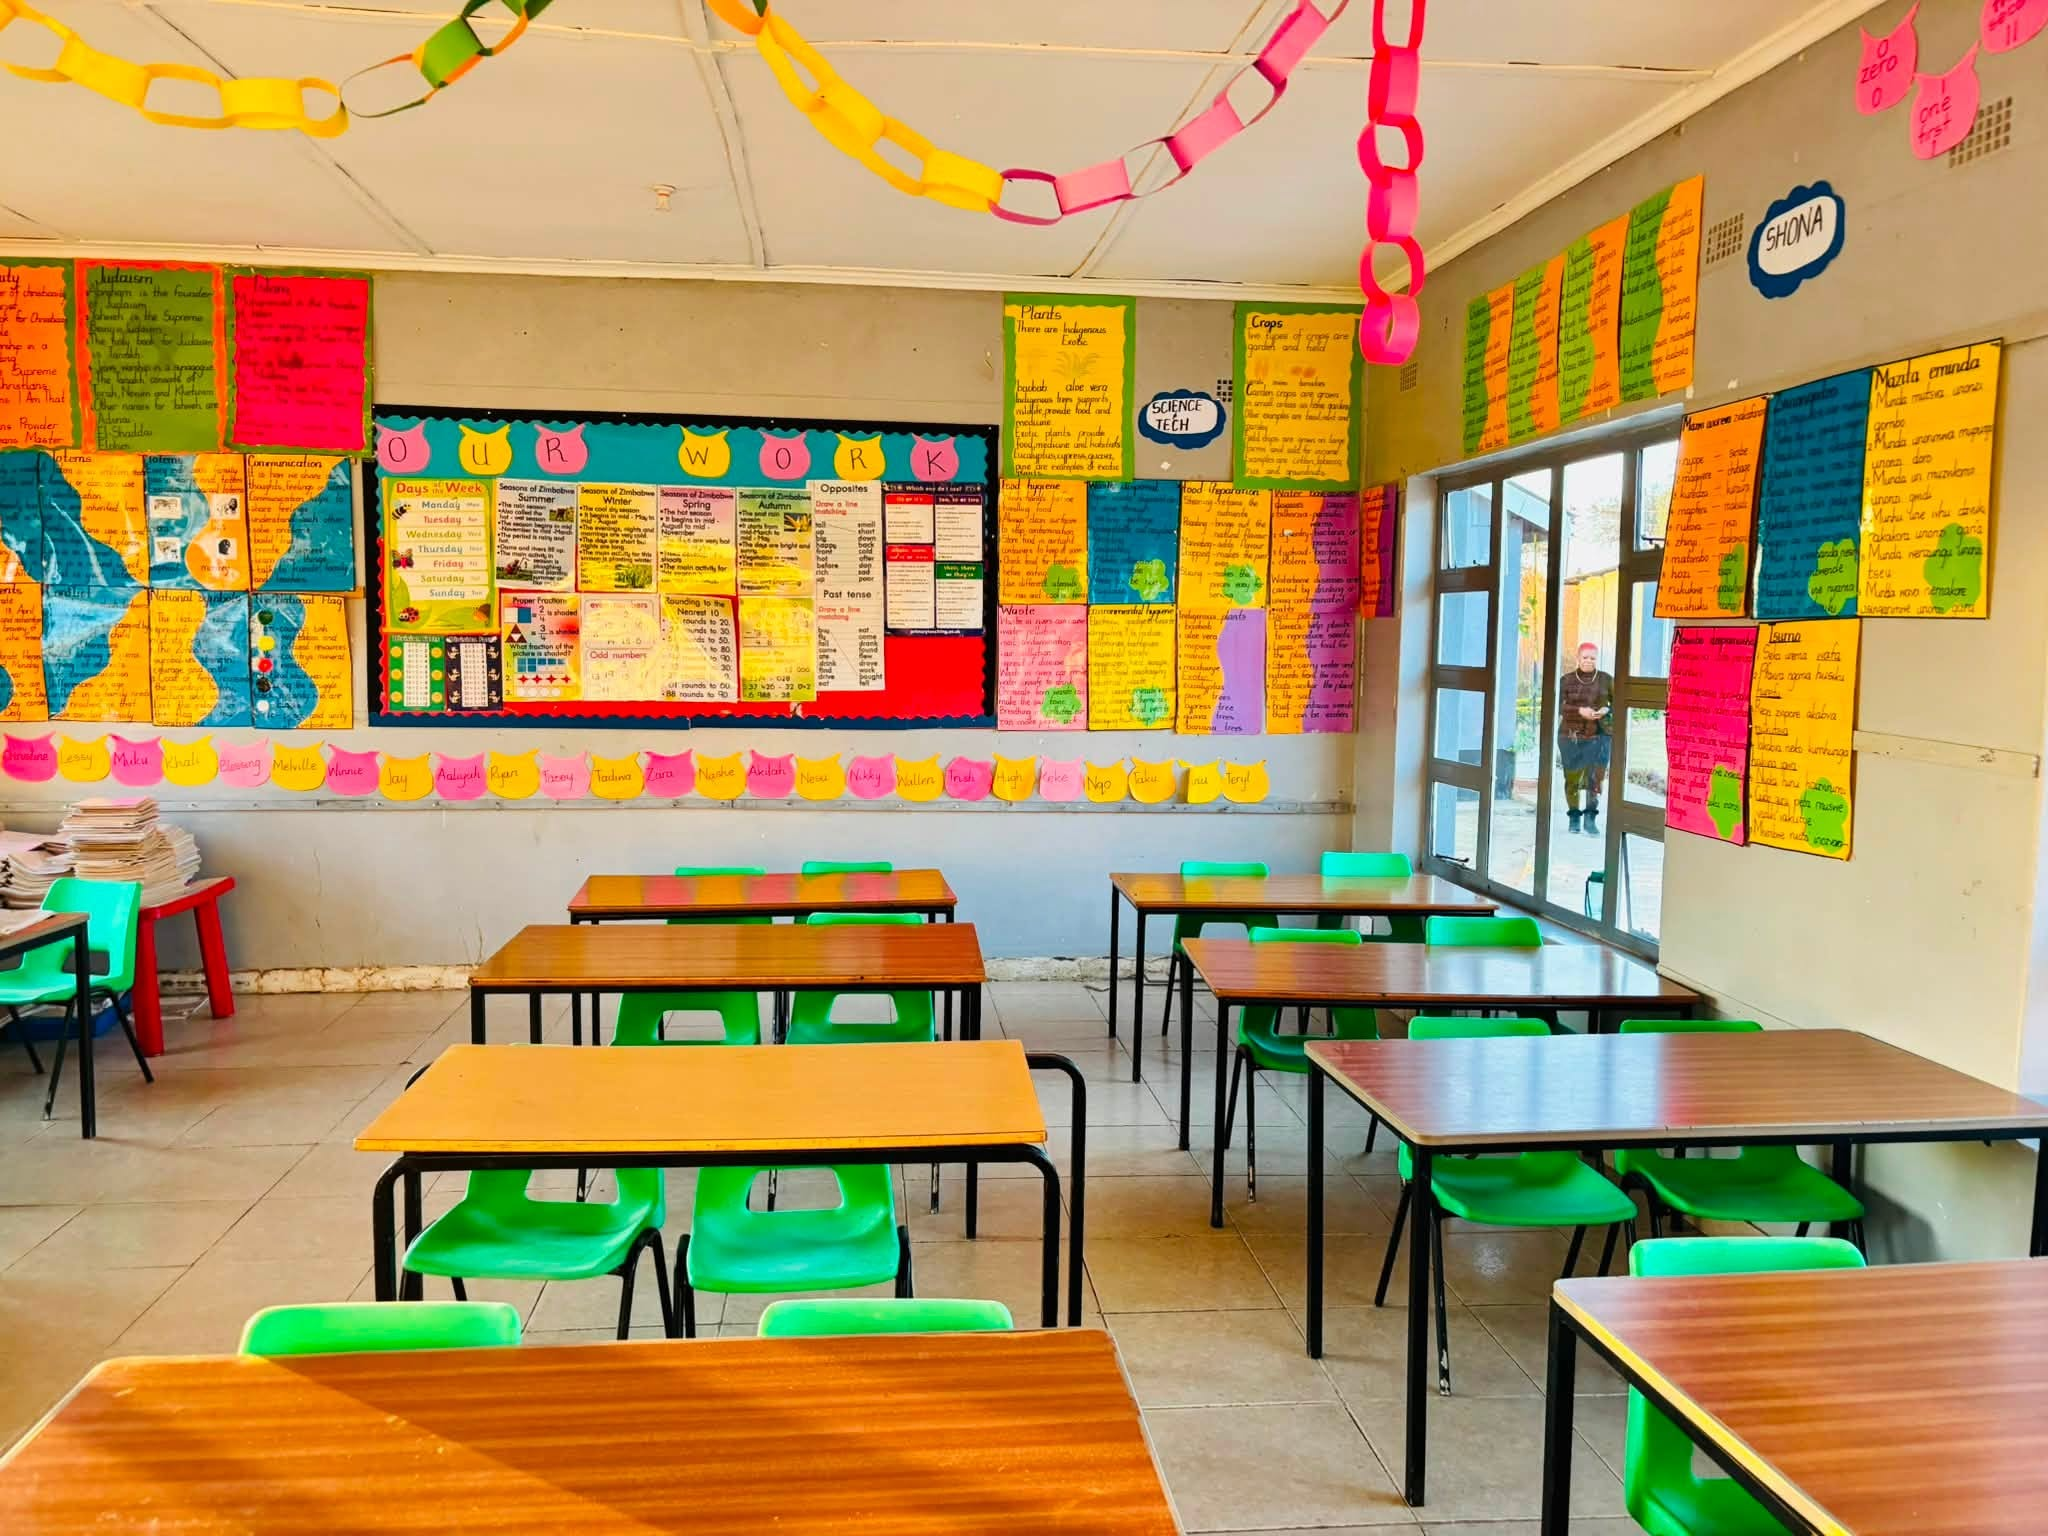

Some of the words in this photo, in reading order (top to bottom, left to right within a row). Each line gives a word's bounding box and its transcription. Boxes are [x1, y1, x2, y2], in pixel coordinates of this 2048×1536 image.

[1766, 204, 1823, 251] SHONA
[100, 266, 153, 284] Judaism
[154, 286, 168, 297] the
[164, 311, 203, 325] Supreme
[1021, 305, 1062, 321] Plants
[1017, 320, 1041, 333] There
[1063, 321, 1107, 341] Indigenous
[1252, 315, 1283, 333] Crops
[1061, 334, 1088, 346] Exotic
[12, 364, 57, 380] Supreme
[1065, 378, 1084, 392] aloe
[1090, 384, 1109, 392] vera
[1075, 402, 1091, 415] food
[1095, 402, 1112, 415] and
[1152, 400, 1203, 414] SCIENCE
[1156, 418, 1189, 432] TECH
[25, 432, 64, 445] Master
[388, 436, 568, 467] OUR
[248, 455, 322, 468] Communication
[685, 446, 947, 477] WORK
[396, 482, 429, 497] Days
[445, 482, 482, 493] Week
[500, 483, 528, 493] Seasons
[530, 485, 538, 493] of
[539, 486, 575, 495] Zimbabwe
[581, 487, 609, 496] Seasons
[610, 488, 618, 496] of
[619, 488, 656, 497] Zimbabwe
[820, 483, 869, 495] Opposites
[1027, 479, 1060, 496] hygiene
[518, 493, 556, 504] Summer
[661, 489, 689, 498] Seasons
[690, 490, 698, 498] of
[698, 490, 734, 500] Zimbabwe
[740, 491, 767, 499] Seasons
[768, 492, 776, 500] of
[777, 493, 812, 501] Zimbabwe
[422, 501, 461, 510] Monday
[603, 497, 633, 506] Winter
[683, 499, 711, 511] Spring
[758, 501, 792, 510] Autumn
[424, 515, 462, 526] Tuesday
[661, 523, 682, 531] August
[406, 530, 462, 539] Wednesday
[418, 545, 463, 554] Thursday
[433, 560, 464, 570] Friday
[421, 575, 465, 584] Saturday
[151, 591, 193, 602] National
[430, 589, 465, 598] Sunday
[823, 590, 842, 599] Past
[847, 591, 872, 599] tense
[513, 597, 536, 605] Proper
[704, 599, 711, 607] to
[714, 599, 725, 608] the
[677, 608, 706, 616] Nearest
[711, 608, 719, 616] 10
[1000, 607, 1036, 616] Waste
[1769, 624, 1802, 643] Tsumo
[590, 651, 609, 659] Odd
[612, 650, 647, 659] numbers
[859, 673, 883, 681] bought
[273, 758, 318, 771] Melville
[328, 762, 364, 777] Winnie
[748, 764, 786, 777] Akilah
[387, 767, 408, 793] Jay
[490, 765, 519, 789] Ryan
[592, 768, 632, 782] Tadiwa
[647, 767, 674, 782] Zara
[849, 768, 881, 788] Nikky
[997, 770, 1023, 790] Hugh
[1225, 771, 1251, 792] Teryl
